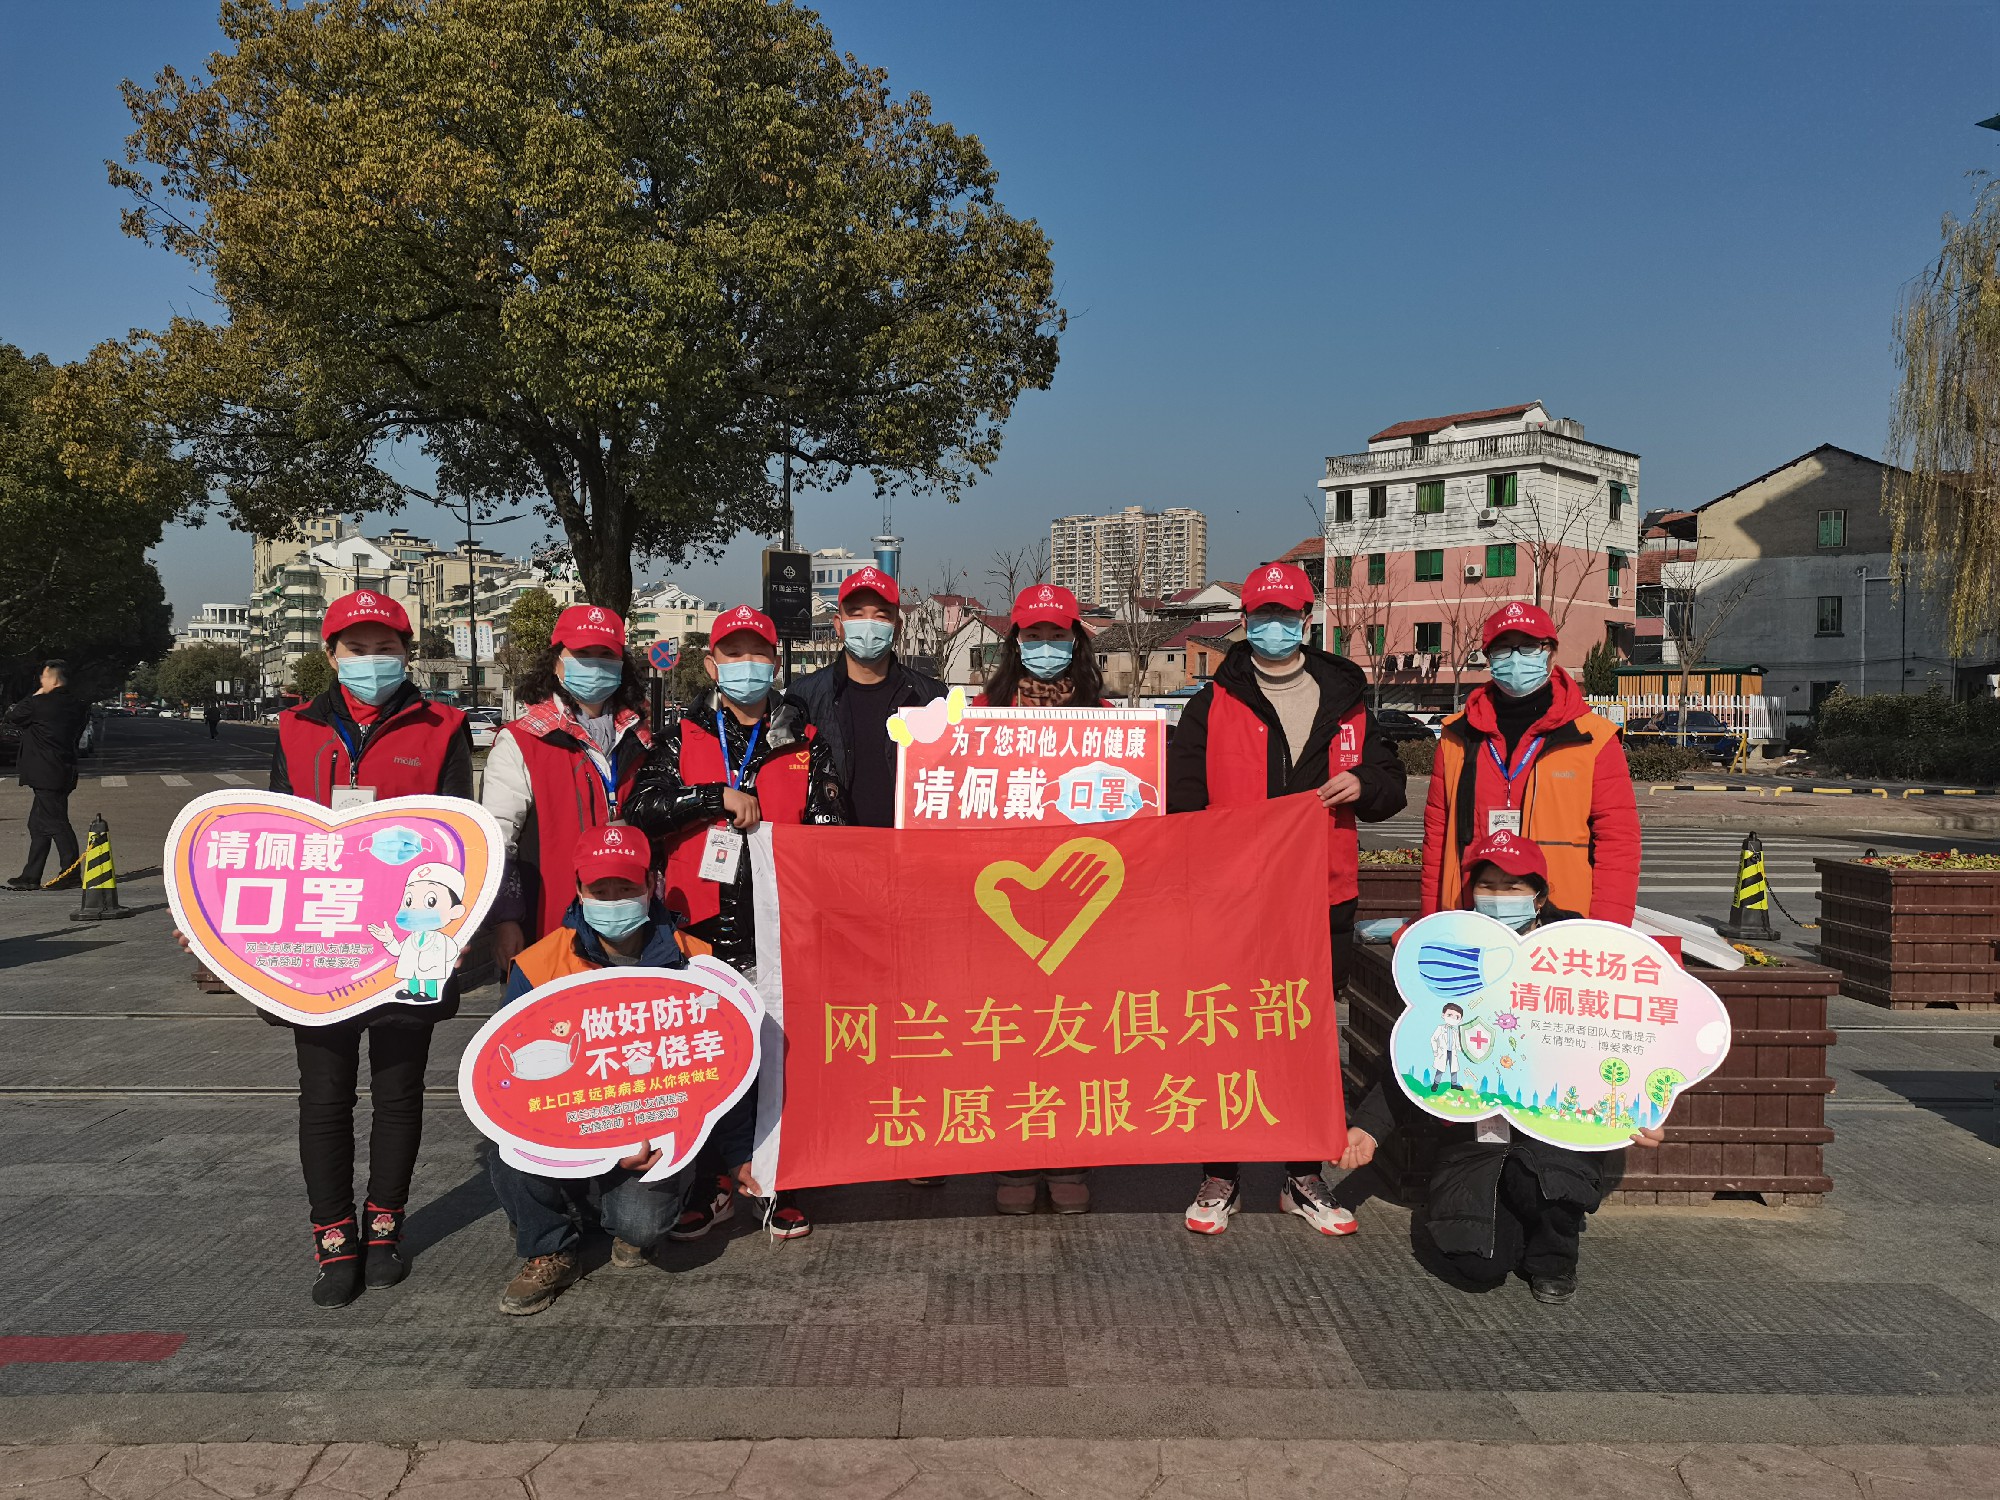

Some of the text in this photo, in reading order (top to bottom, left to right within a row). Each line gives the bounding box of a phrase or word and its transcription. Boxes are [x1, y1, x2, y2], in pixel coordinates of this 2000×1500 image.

[950, 724, 1147, 759] 为了您和他人的健康
[913, 765, 1127, 821] 请佩戴 口罩
[206, 830, 345, 872] 请佩戴
[220, 877, 365, 938] 口罩
[245, 941, 374, 955] 网兰志愿者团队友情提示
[1529, 945, 1663, 986] 公共场合
[580, 989, 719, 1043] 做好防护
[824, 977, 1312, 1065] 网兰车友俱乐部
[1510, 981, 1679, 1026] 请佩戴口罩
[585, 1029, 725, 1080] 不容侥幸
[1530, 1019, 1657, 1044] 网兰志愿者团队友情提示
[866, 1068, 1280, 1147] 志愿者服务队
